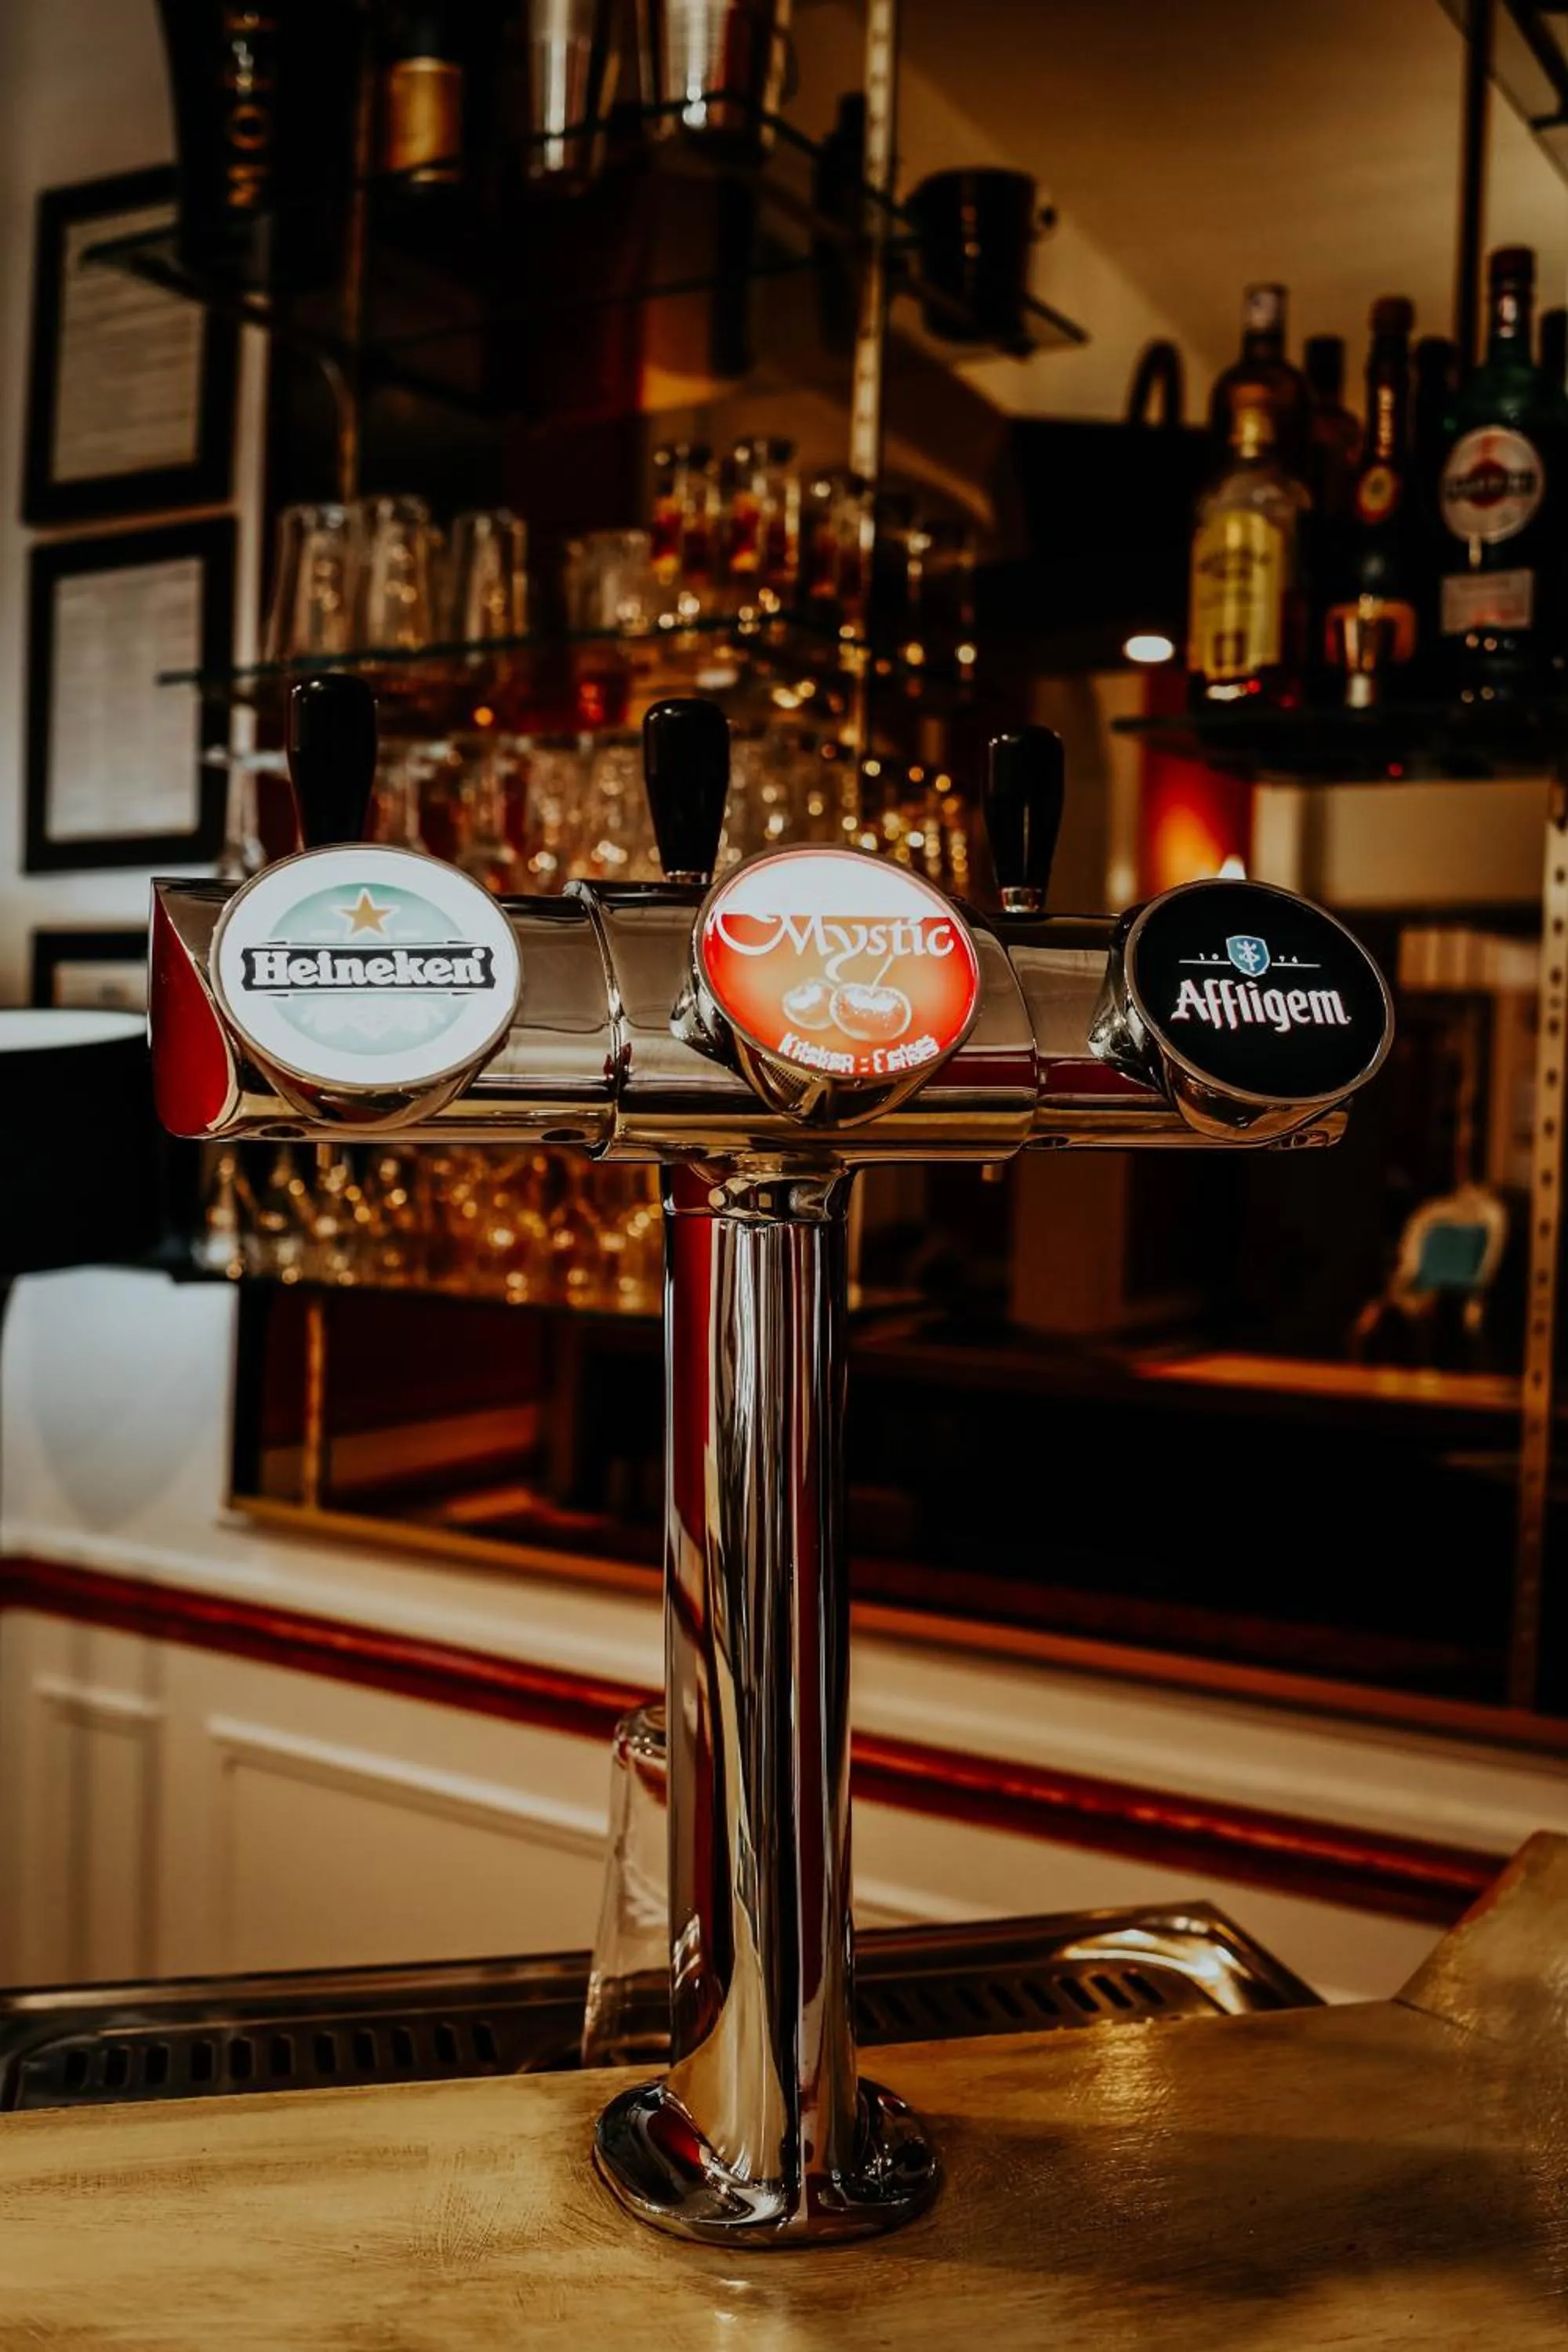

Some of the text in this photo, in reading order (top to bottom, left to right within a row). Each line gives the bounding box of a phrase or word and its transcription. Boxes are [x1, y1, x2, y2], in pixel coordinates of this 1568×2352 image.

[251, 948, 486, 986] Heineken
[715, 906, 955, 981] Mystic
[1171, 978, 1352, 1033] Affligem
